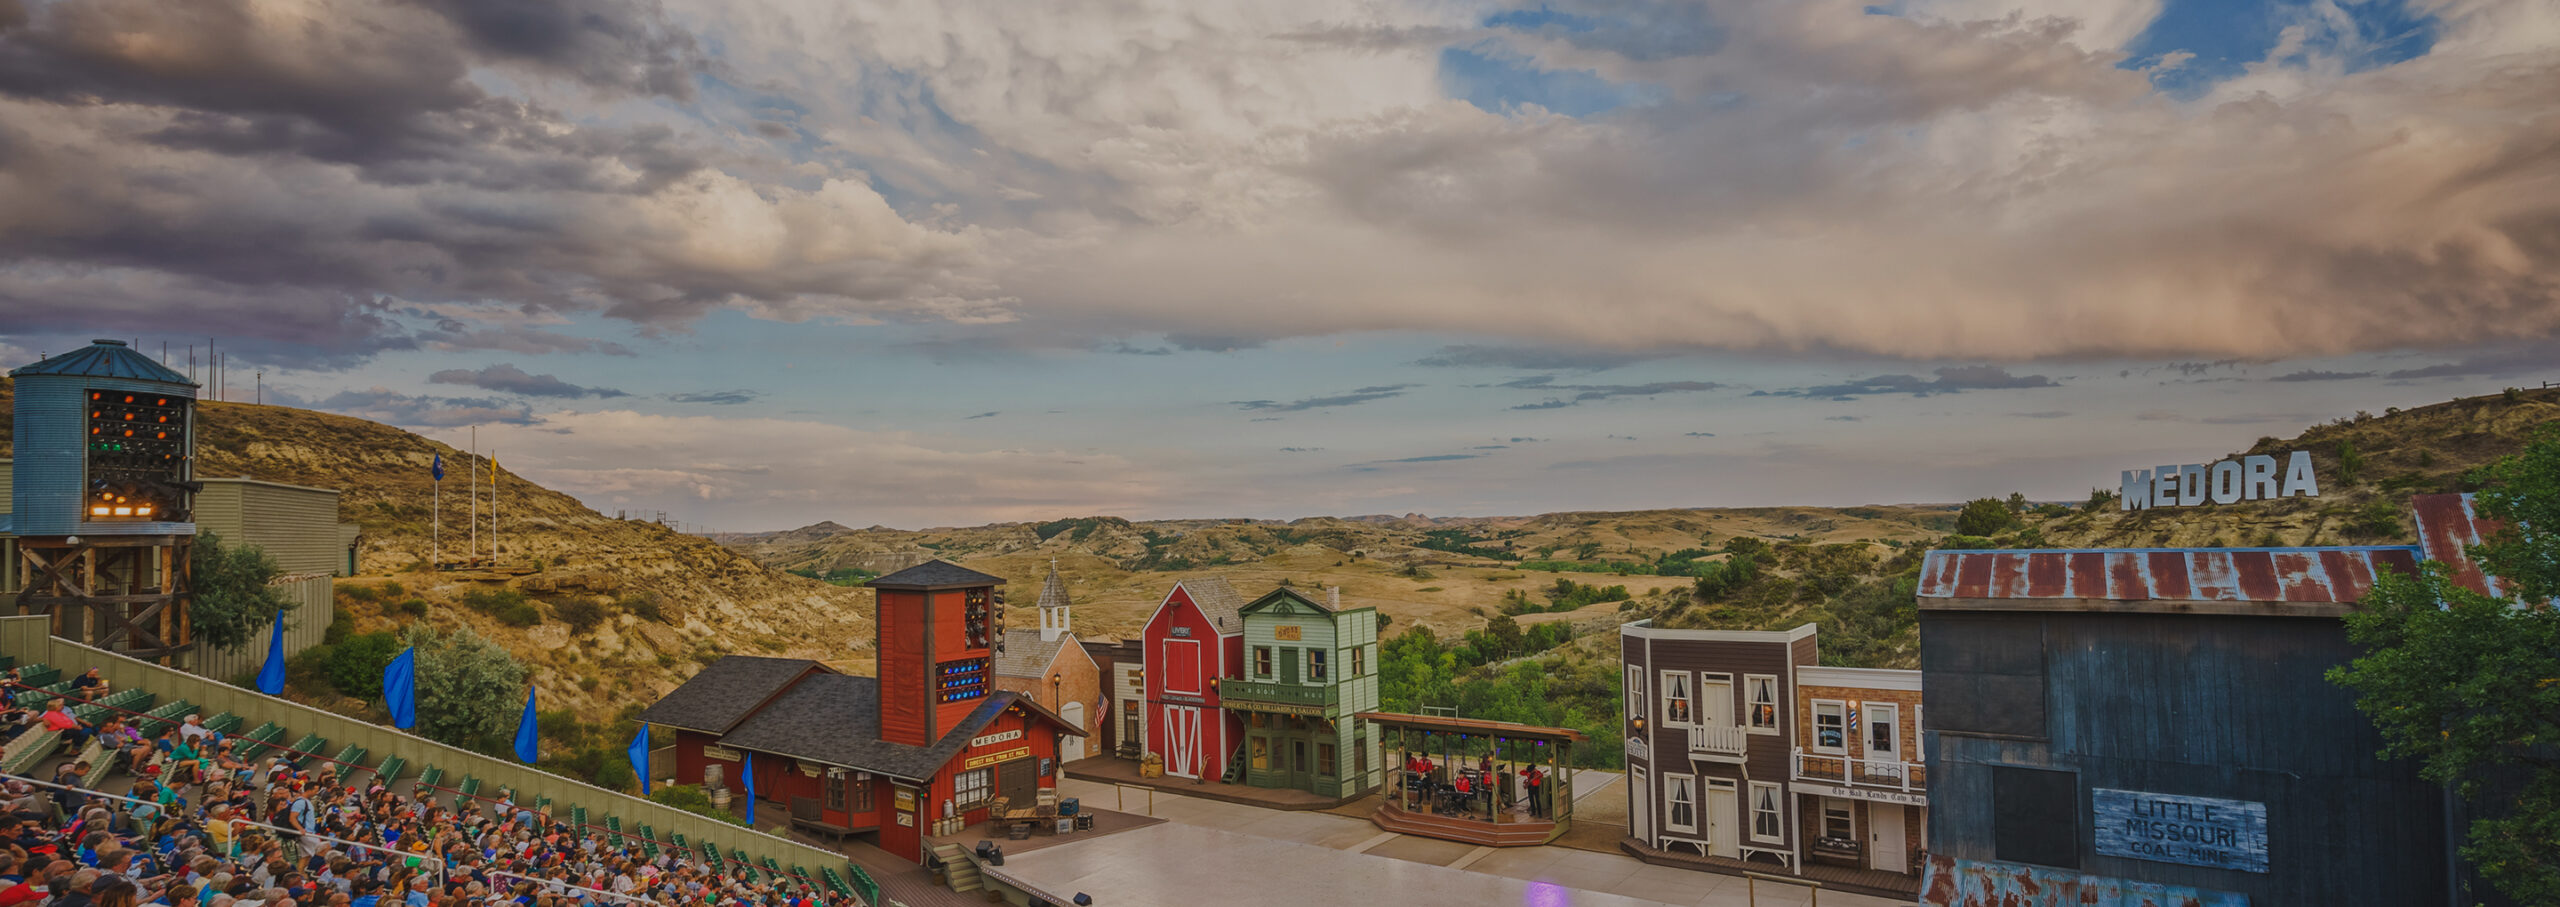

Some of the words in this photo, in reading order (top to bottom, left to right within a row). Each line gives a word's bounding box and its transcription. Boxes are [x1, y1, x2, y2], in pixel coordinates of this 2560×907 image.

[2121, 450, 2319, 511] MEDORA
[1223, 700, 1247, 709] ROBERTS
[1263, 704, 1292, 713] BILLIARDS
[1298, 707, 1322, 715] SALOON
[975, 731, 1019, 745] MEDORA
[969, 758, 984, 767] DIRECT
[1832, 787, 1845, 796] The
[1849, 789, 1862, 797] Bad
[1867, 791, 1887, 800] Lands
[1891, 793, 1907, 801] Cow
[1911, 794, 1926, 805] Boy
[2133, 798, 2222, 824] LITTLE
[2126, 818, 2237, 848] MISSOURI
[2131, 841, 2176, 858] COAL
[2188, 847, 2230, 864] MINE
